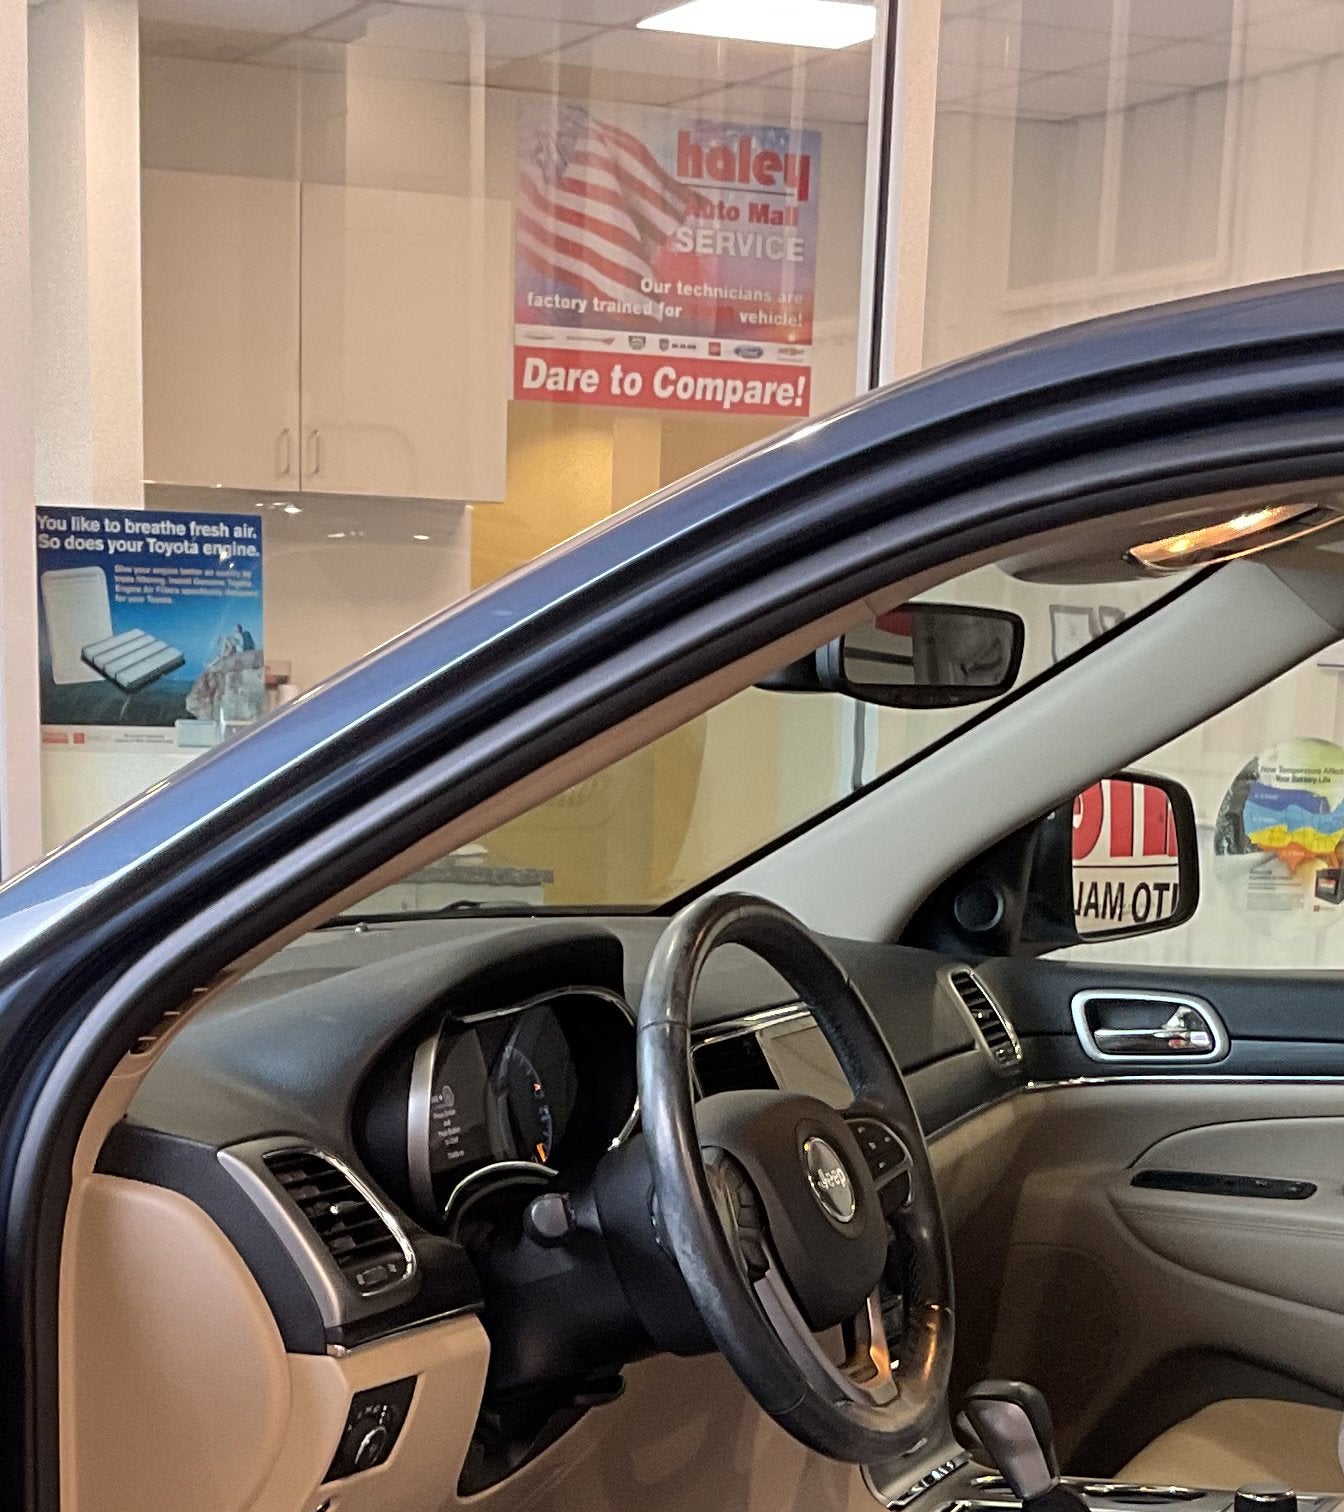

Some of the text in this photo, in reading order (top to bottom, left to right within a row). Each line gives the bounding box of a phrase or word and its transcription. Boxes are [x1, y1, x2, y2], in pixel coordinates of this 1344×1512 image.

[676, 130, 812, 202] haley
[683, 200, 801, 226] Auto Mall
[675, 227, 805, 262] SERVICE
[641, 276, 804, 306] Our technicians are
[527, 292, 683, 318] factory trained for
[739, 307, 804, 328] vehicle!
[523, 358, 806, 410] Dare to Compare!
[37, 515, 257, 539] You like to breathe fresh air.
[37, 534, 260, 558] So does your Toyota engine.
[817, 1167, 847, 1190] Jeep
